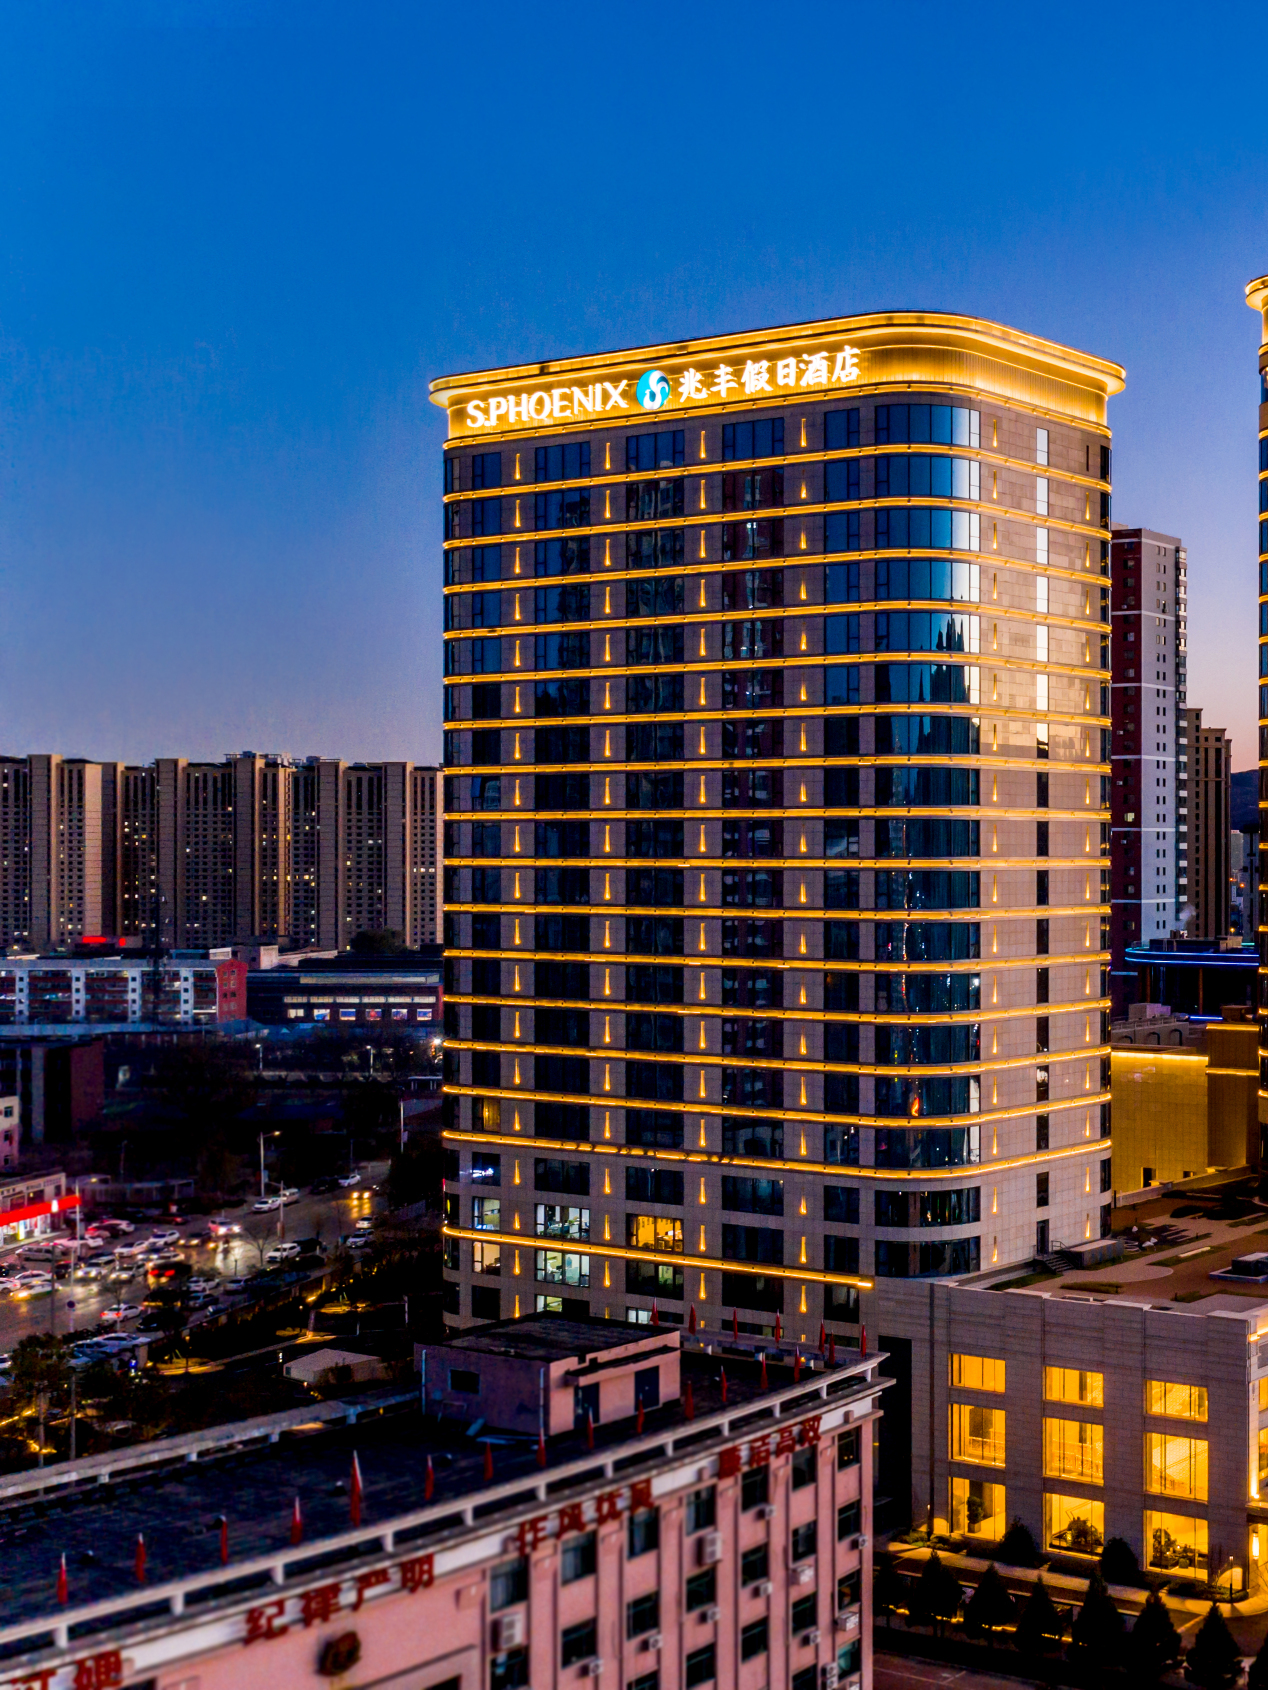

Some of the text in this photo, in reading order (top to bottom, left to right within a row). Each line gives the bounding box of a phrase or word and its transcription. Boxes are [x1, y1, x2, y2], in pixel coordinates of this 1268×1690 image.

[678, 345, 862, 403] 兆丰假日酒店
[466, 380, 630, 428] S.PHOENIX
[243, 1552, 434, 1646] 纪律严明
[517, 1478, 655, 1557] 作风优良
